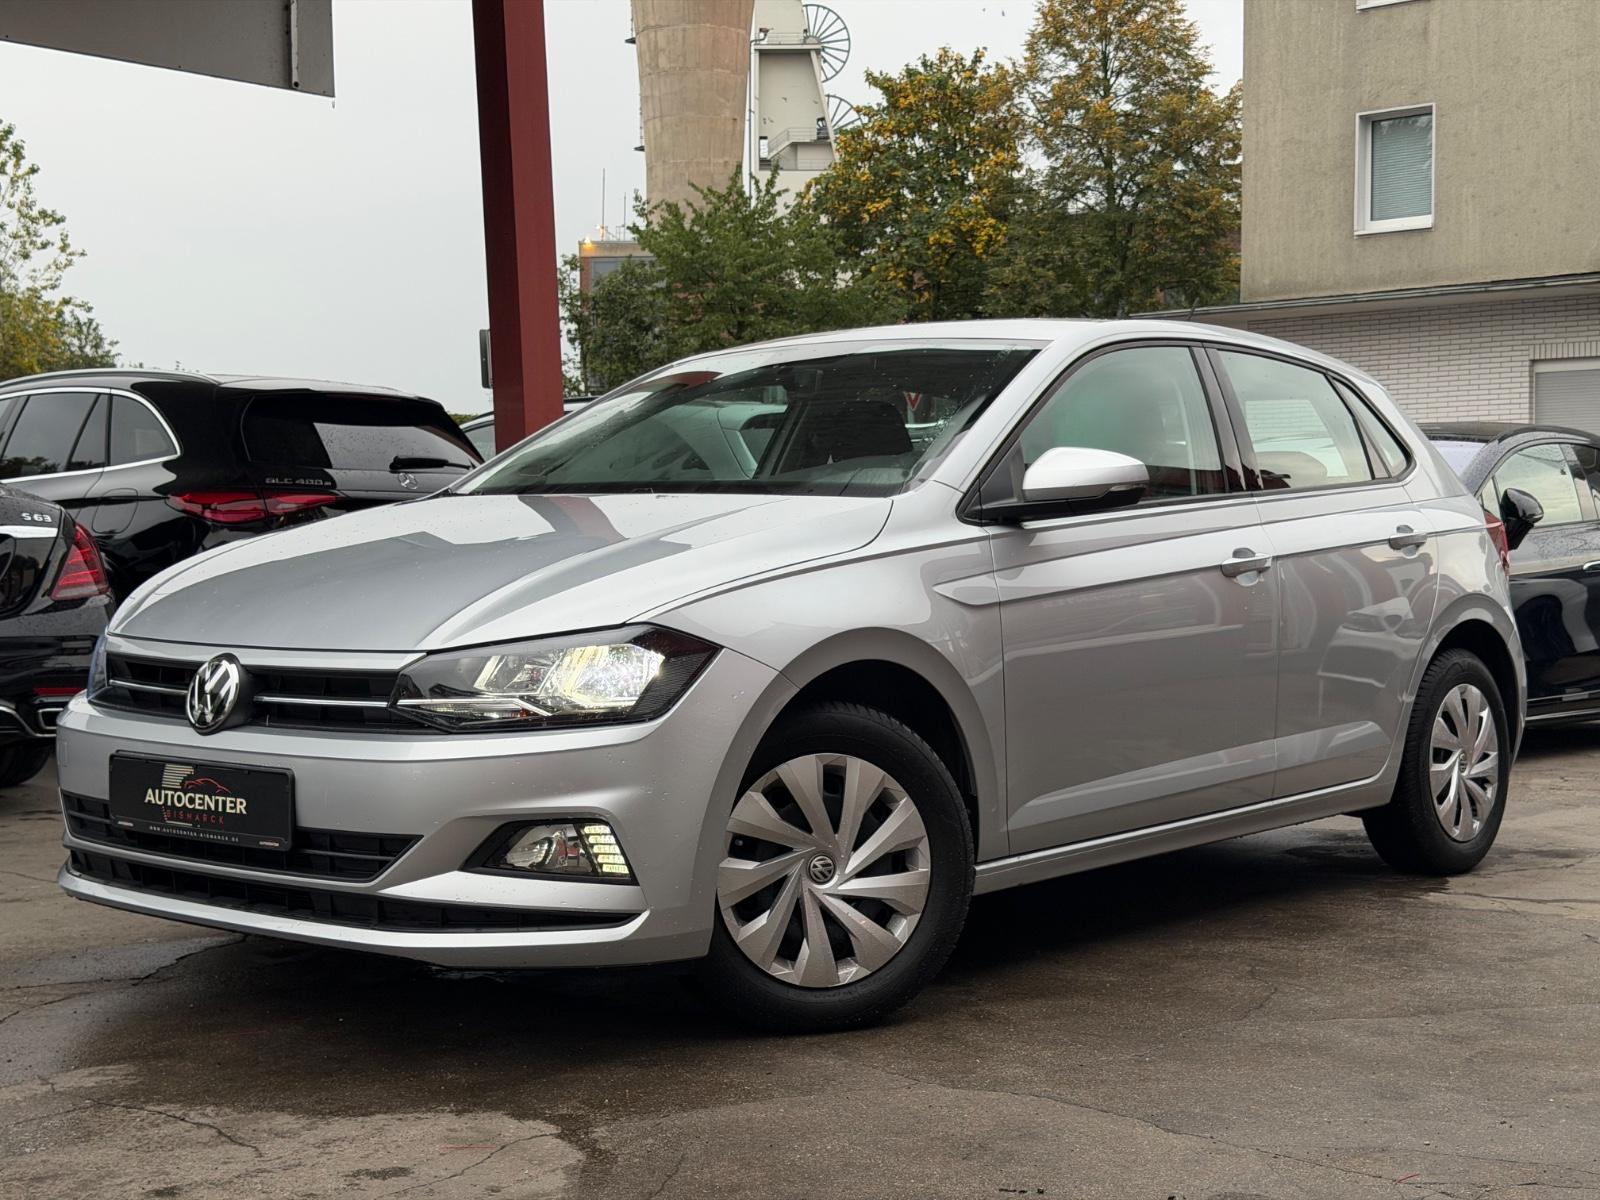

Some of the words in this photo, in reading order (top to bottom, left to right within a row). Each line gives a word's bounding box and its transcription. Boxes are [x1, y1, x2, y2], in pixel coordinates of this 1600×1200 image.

[265, 477, 293, 485] GLC
[144, 788, 248, 814] AUTOCENTER
[165, 810, 224, 825] BISMARCK
